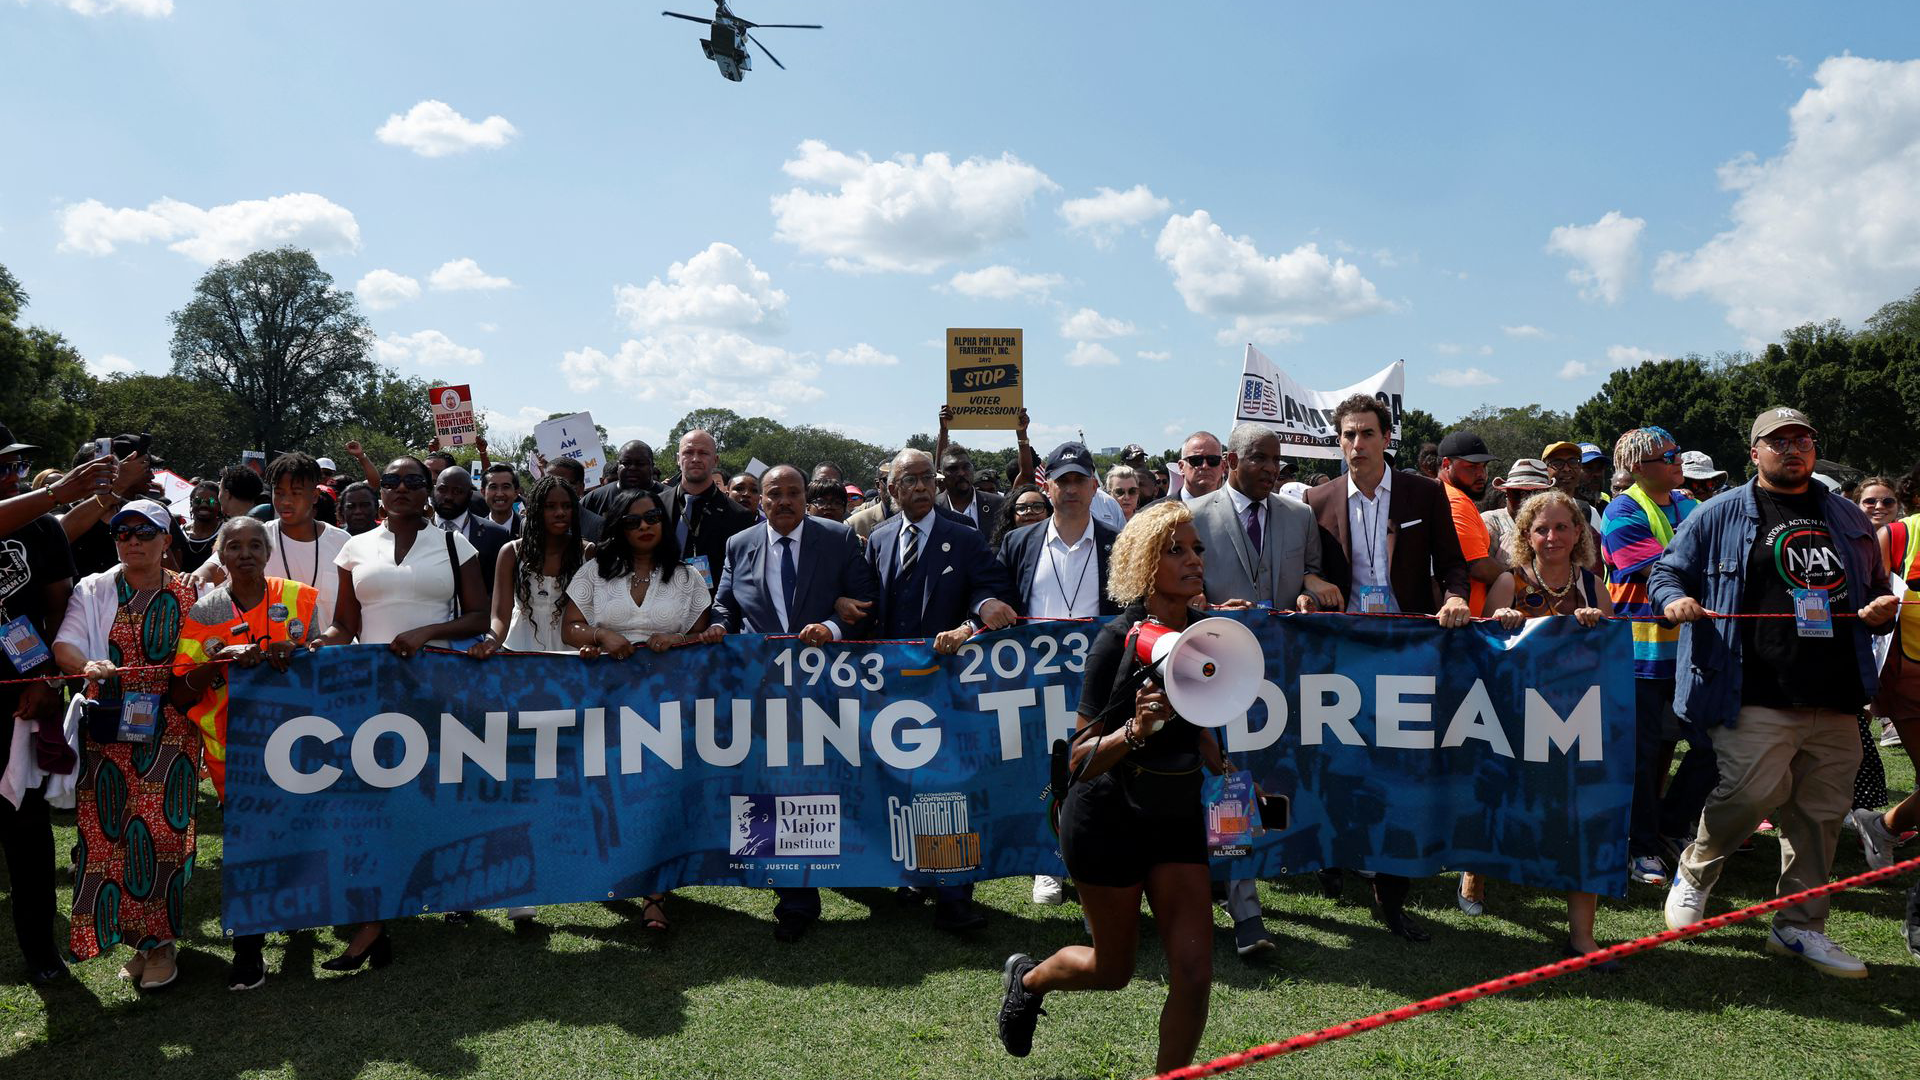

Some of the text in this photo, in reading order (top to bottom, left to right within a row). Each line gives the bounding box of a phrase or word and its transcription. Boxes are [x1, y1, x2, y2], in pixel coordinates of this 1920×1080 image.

[954, 337, 1016, 346] ALPHA PHI ALPHA
[959, 347, 1010, 356] FRATERNITY, INC.
[963, 368, 1006, 388] STOP
[969, 396, 1001, 405] VOTER
[950, 406, 1020, 415] SUPPRESSION!
[436, 417, 474, 427] FRONTLINES
[438, 424, 475, 435] FOR JUSTICE
[562, 428, 567, 436] I
[560, 438, 577, 449] AM
[1278, 433, 1331, 445] OWERING
[1765, 522, 1787, 546] NATIONAL
[1788, 519, 1817, 527] ACTION
[1786, 547, 1845, 571] NAN
[21, 654, 49, 672] ALL ACCESS
[774, 646, 885, 691] 1963
[958, 632, 1089, 684] 2023
[263, 698, 942, 794] CONTINUING
[978, 685, 1078, 762] TH
[1228, 674, 1604, 762] DREAM
[919, 795, 966, 803] CONTINUATION
[780, 801, 836, 816] Drum
[912, 800, 969, 835] MARCH ON
[780, 818, 836, 836] Major
[888, 796, 917, 871] 60
[780, 838, 835, 850] Institute
[916, 832, 981, 868] WASHINGTON
